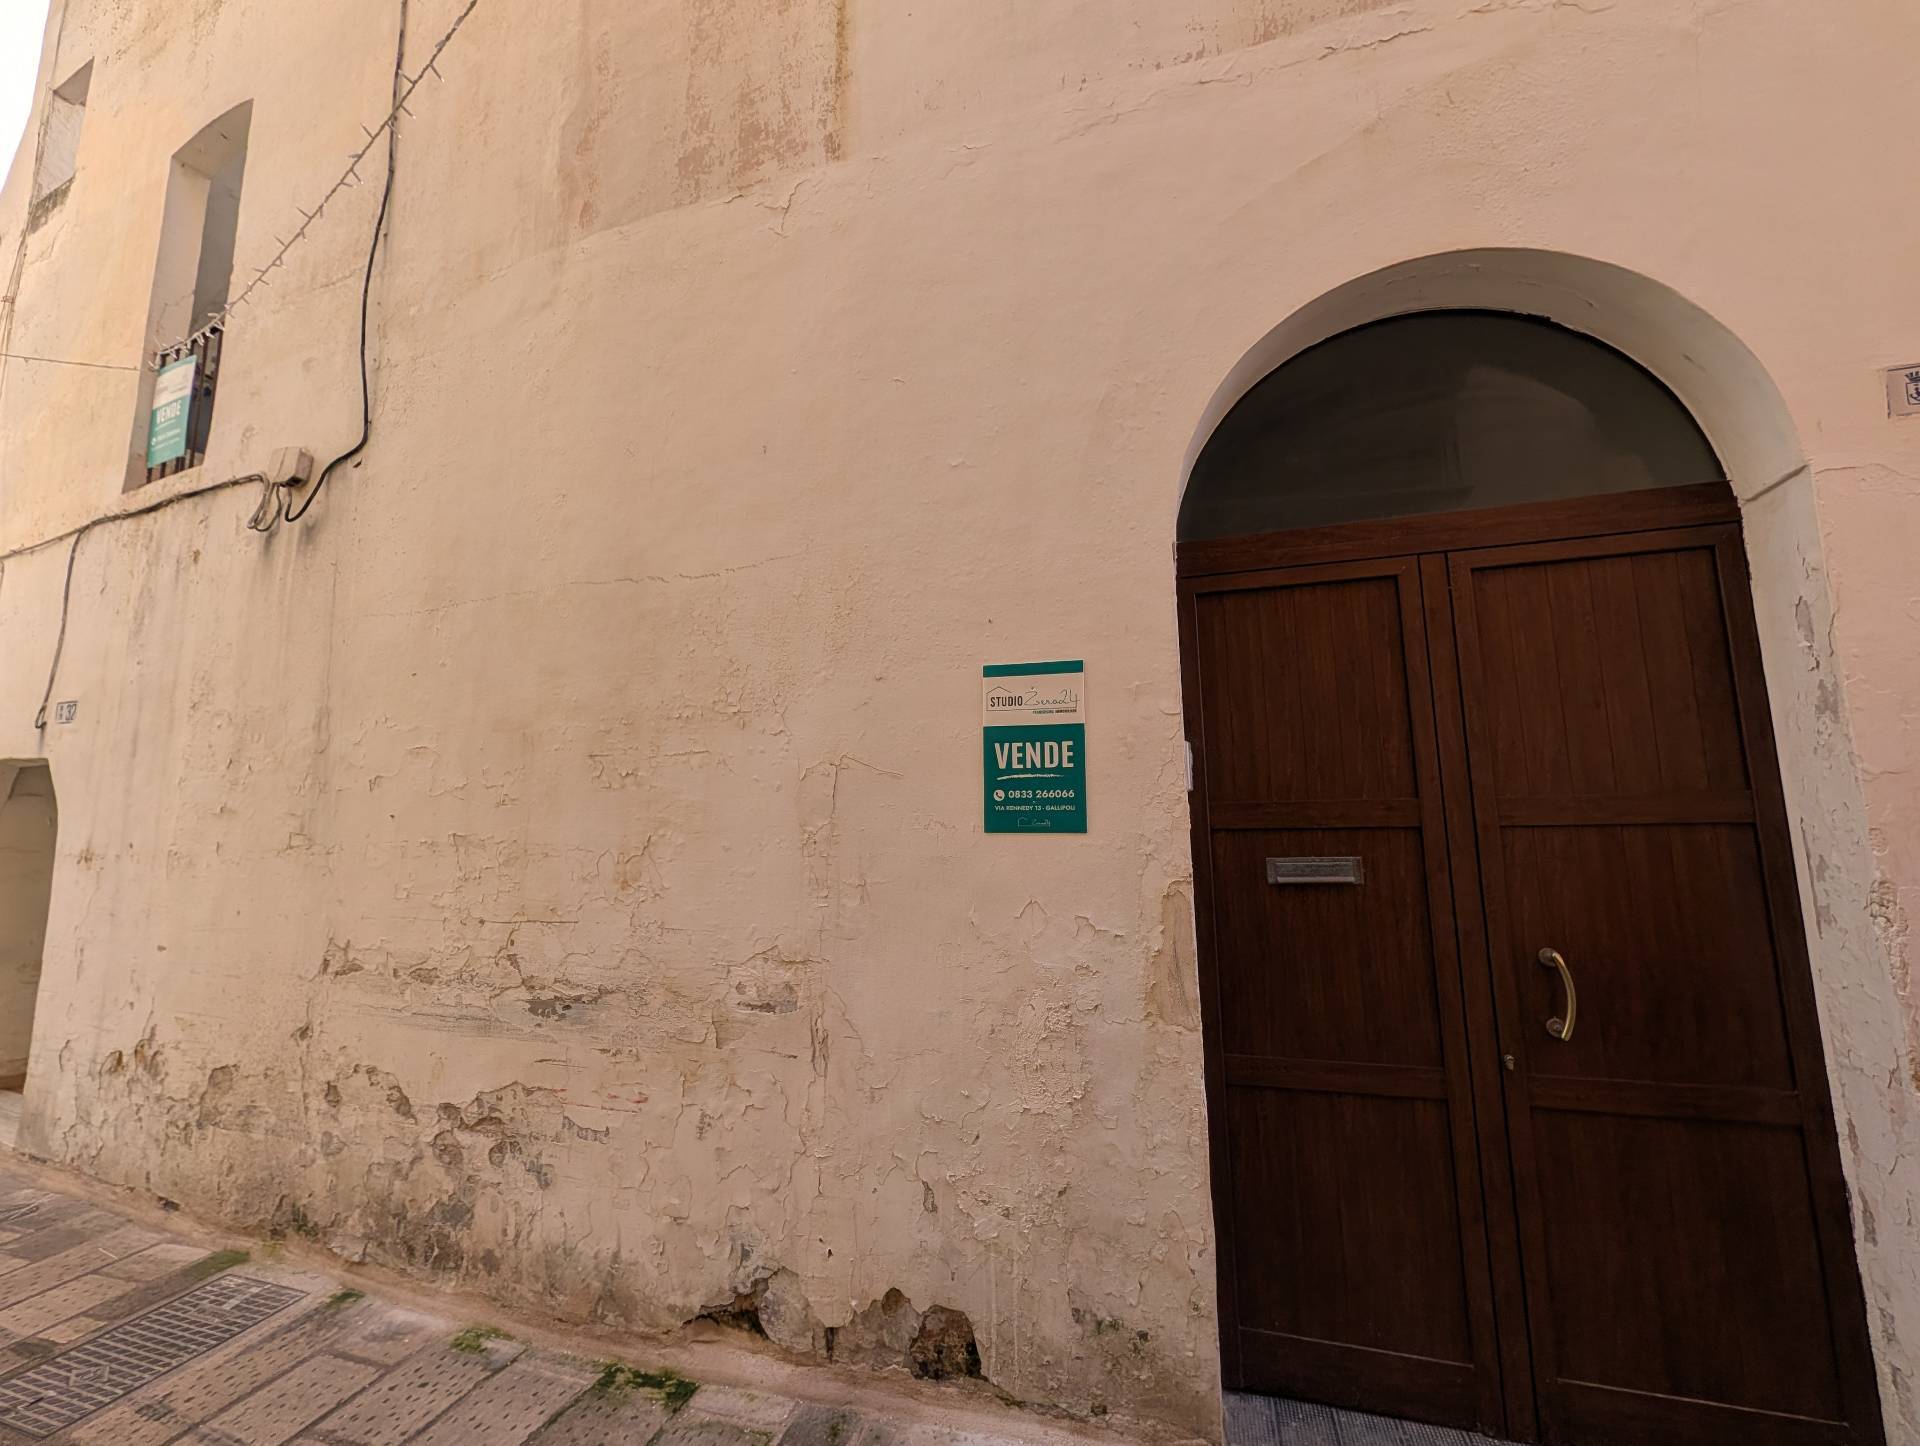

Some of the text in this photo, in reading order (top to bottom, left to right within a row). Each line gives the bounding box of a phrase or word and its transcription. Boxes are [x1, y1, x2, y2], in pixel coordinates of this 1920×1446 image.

[156, 400, 181, 424] VENDE
[990, 696, 1023, 707] STUDIO
[994, 740, 1074, 769] VENDE
[1008, 789, 1075, 799] 0833 266066
